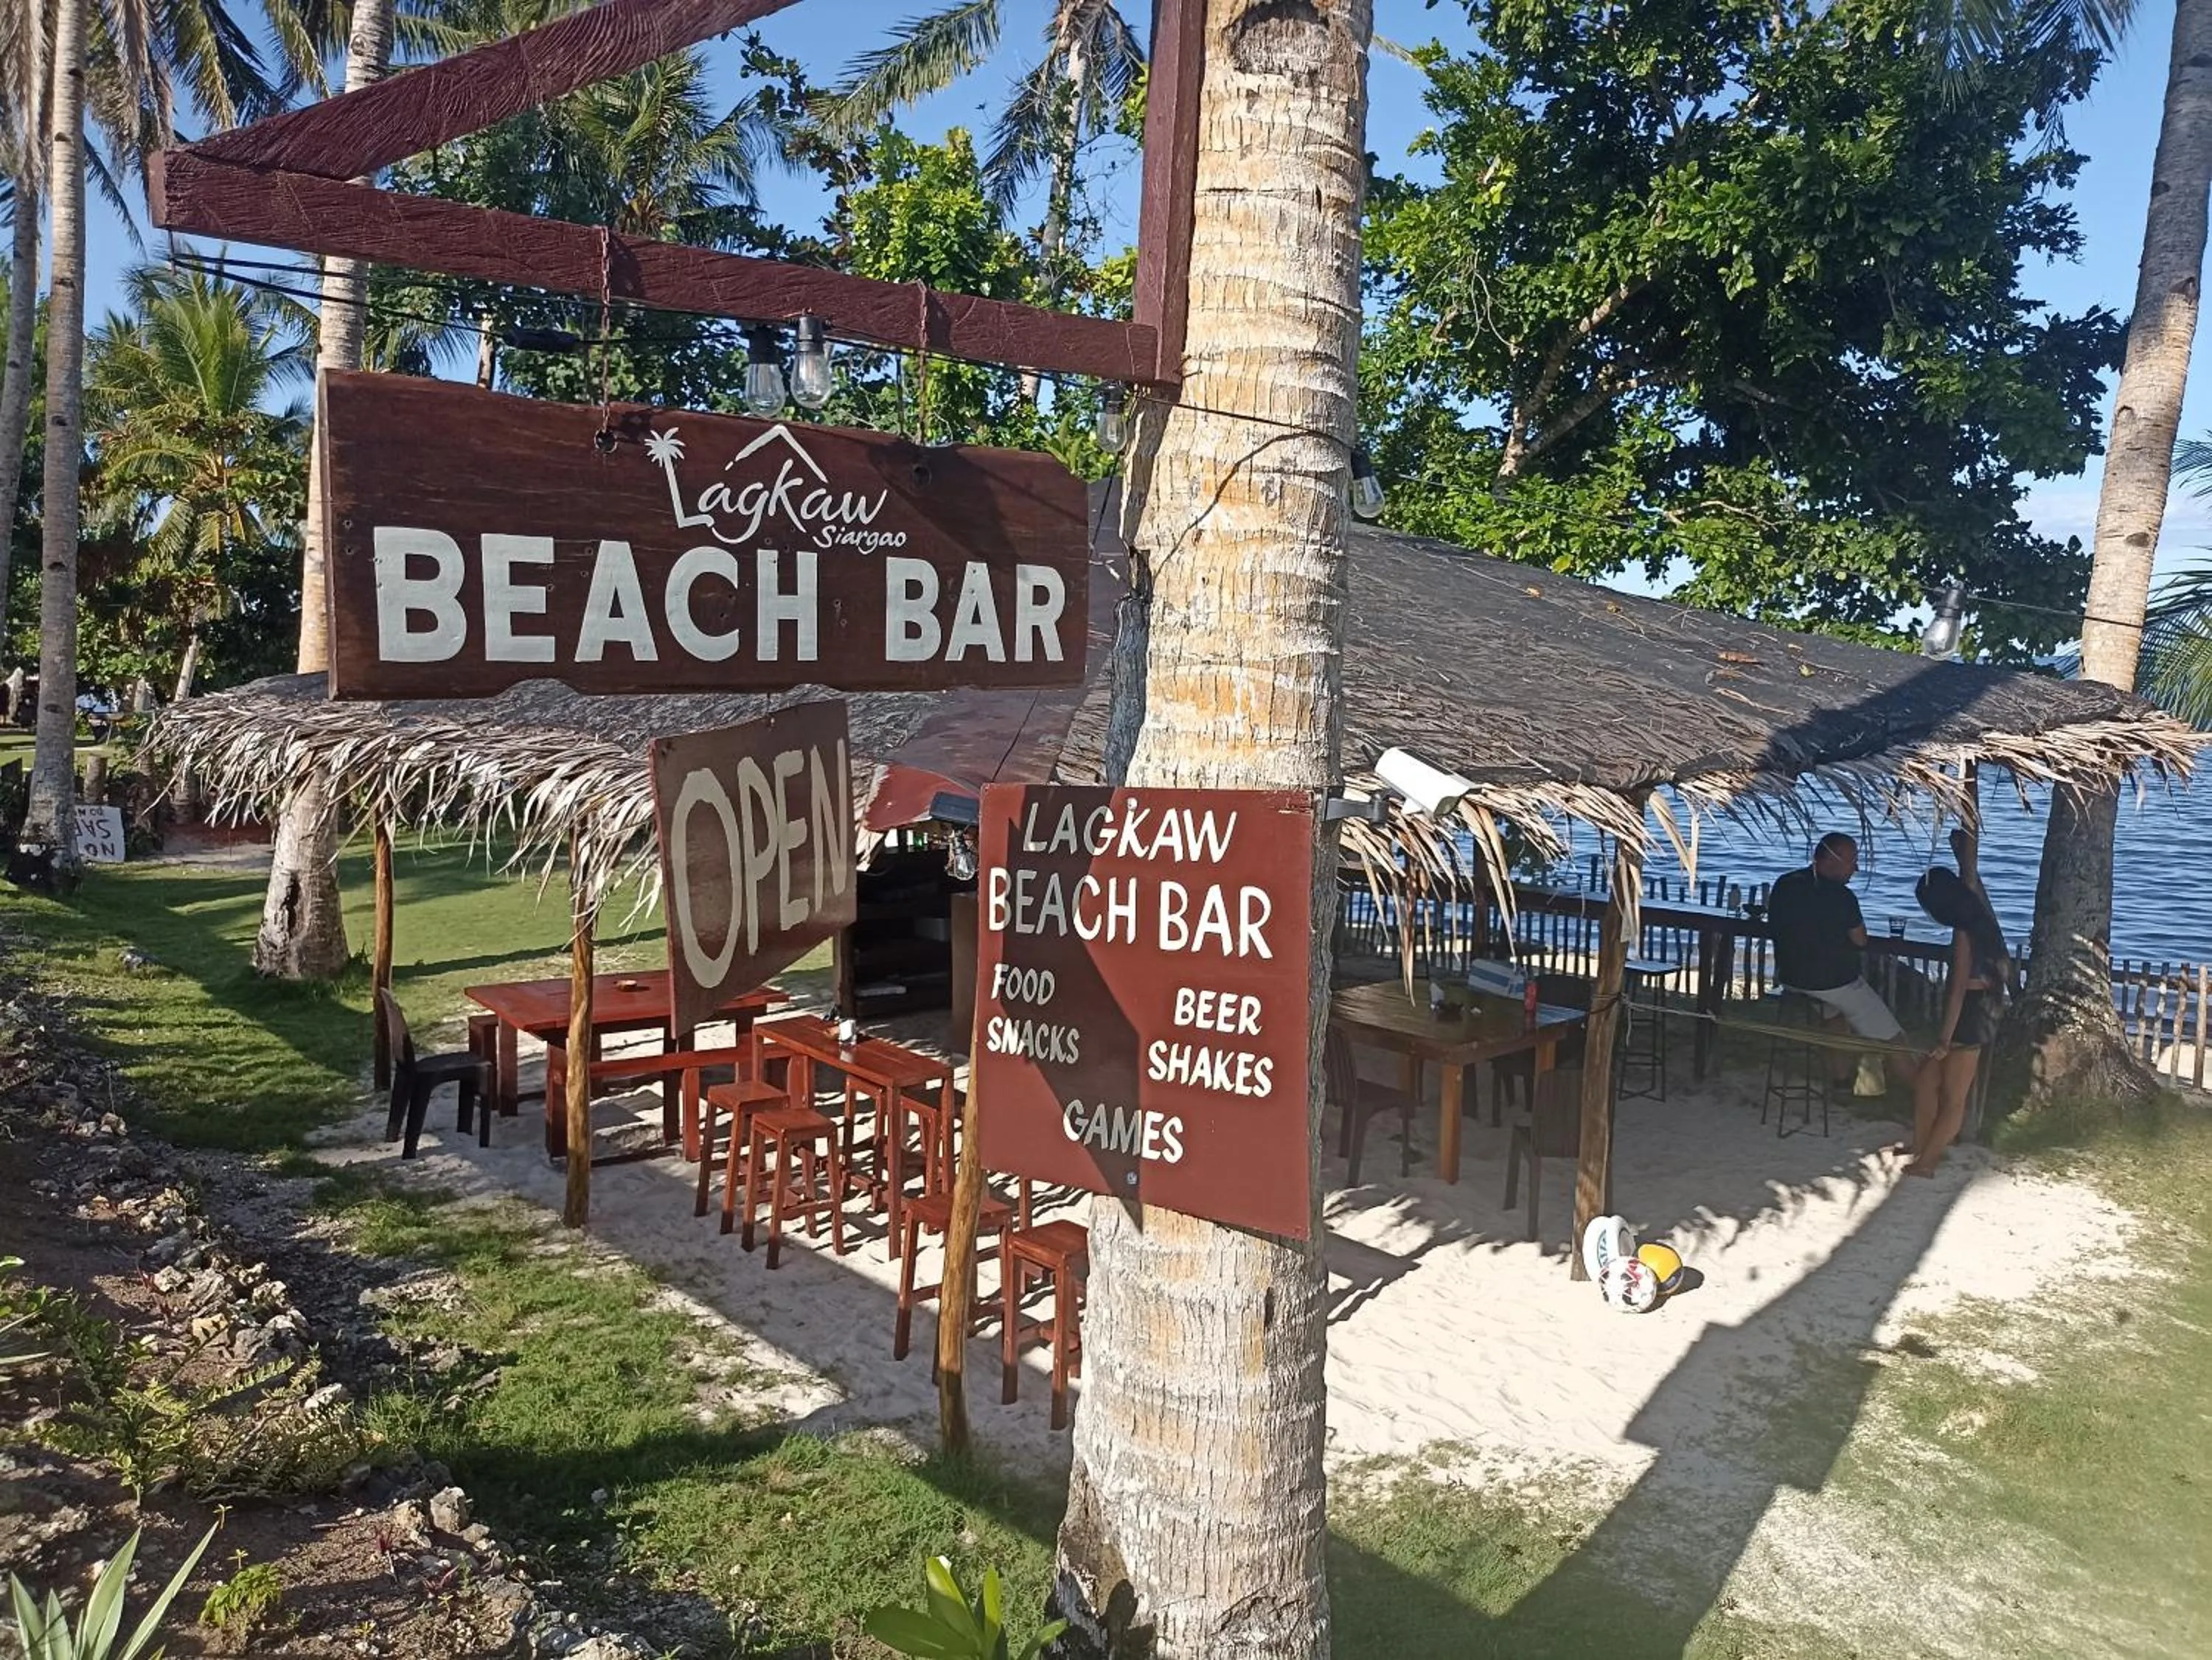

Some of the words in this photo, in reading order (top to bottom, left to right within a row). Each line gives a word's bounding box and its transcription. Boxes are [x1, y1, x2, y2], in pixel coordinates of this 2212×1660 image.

[813, 524, 907, 555] Siargao
[372, 526, 818, 663] BEACH
[886, 556, 1065, 663] BAR
[670, 738, 847, 988] OPEN
[1023, 801, 1238, 864] LAGKAW
[988, 866, 1137, 944] BEACH
[1158, 880, 1273, 960] BAR
[990, 963, 1055, 1005] FOOD
[1173, 987, 1262, 1036] BEER
[986, 1015, 1080, 1064] SNACKS
[1147, 1039, 1274, 1098] SHAKES
[1062, 1099, 1183, 1164] GAMES
